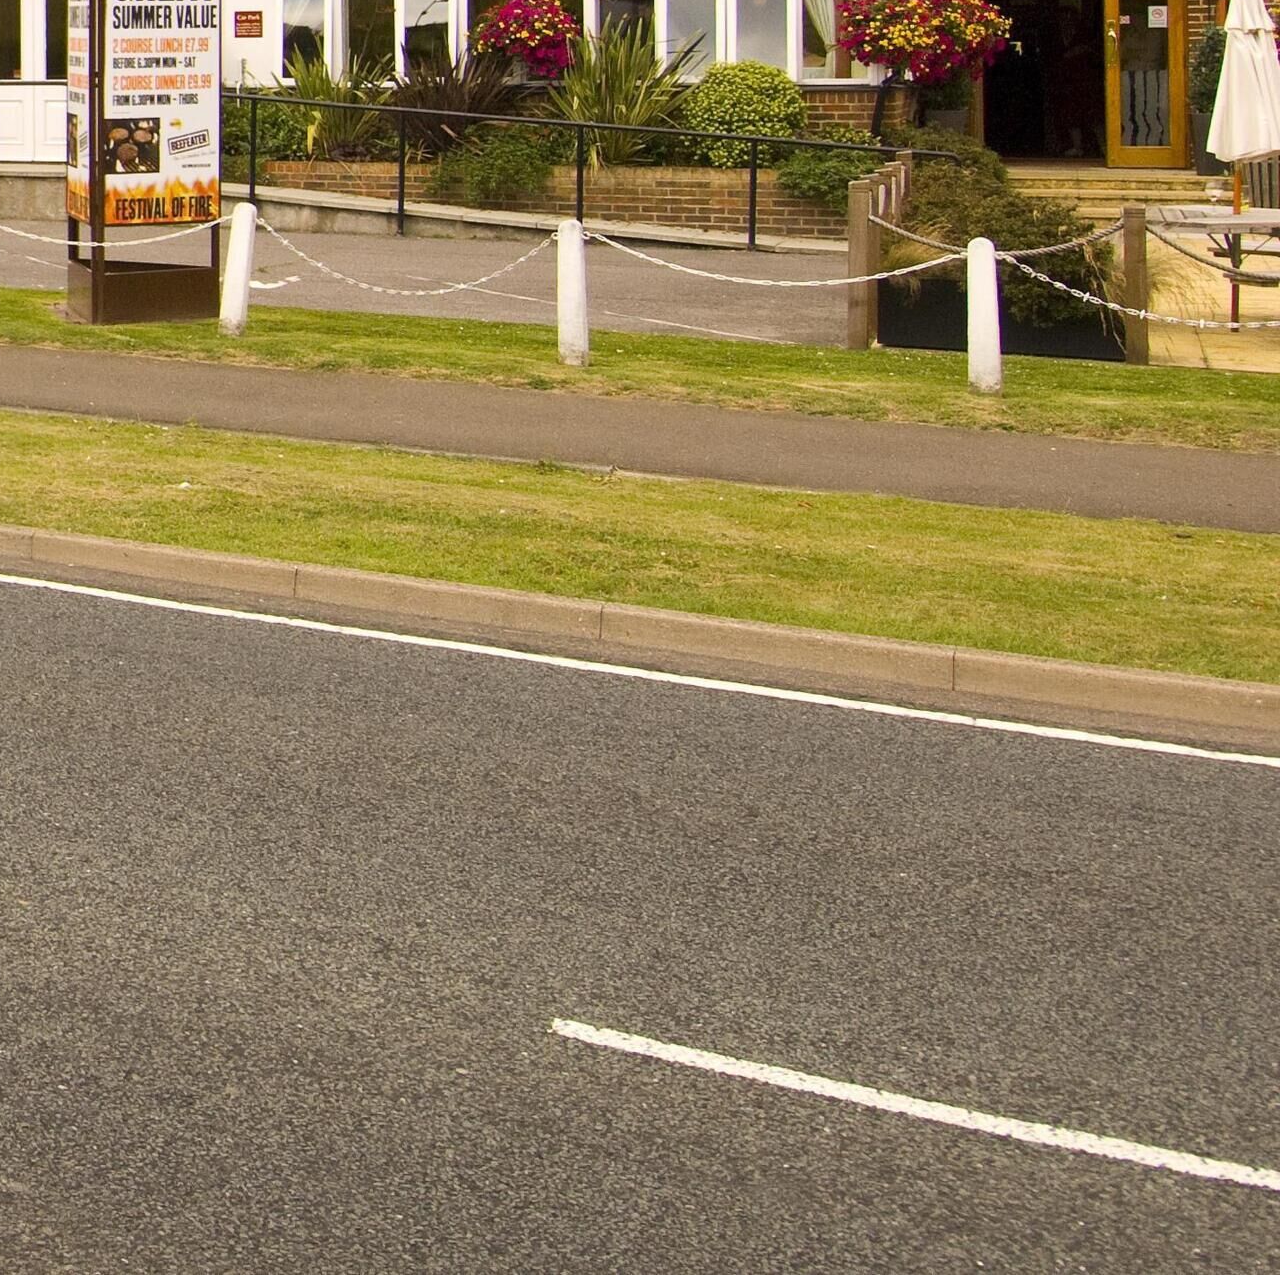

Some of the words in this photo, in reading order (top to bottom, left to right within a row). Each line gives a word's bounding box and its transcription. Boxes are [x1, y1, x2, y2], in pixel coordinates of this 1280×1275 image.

[112, 5, 173, 30] SUMMER
[176, 4, 218, 29] VALUE
[112, 37, 119, 53] 2
[120, 37, 153, 53] COURSE
[155, 37, 183, 53] LUNCH
[112, 57, 136, 69] BEFORE
[137, 57, 161, 69] 6.30PM
[162, 56, 177, 68] MON
[183, 56, 196, 68] SAT
[112, 74, 119, 91] 2
[120, 74, 153, 91] COURSE
[155, 74, 186, 90] DINNER
[112, 94, 130, 106] FROM
[132, 94, 155, 106] 6.30PM
[156, 94, 171, 105] MON
[178, 93, 199, 105] THURS
[170, 133, 207, 151] BEEFEATER
[115, 197, 167, 221] FESTIVAL
[171, 196, 187, 218] OF
[188, 195, 213, 218] FIRE
